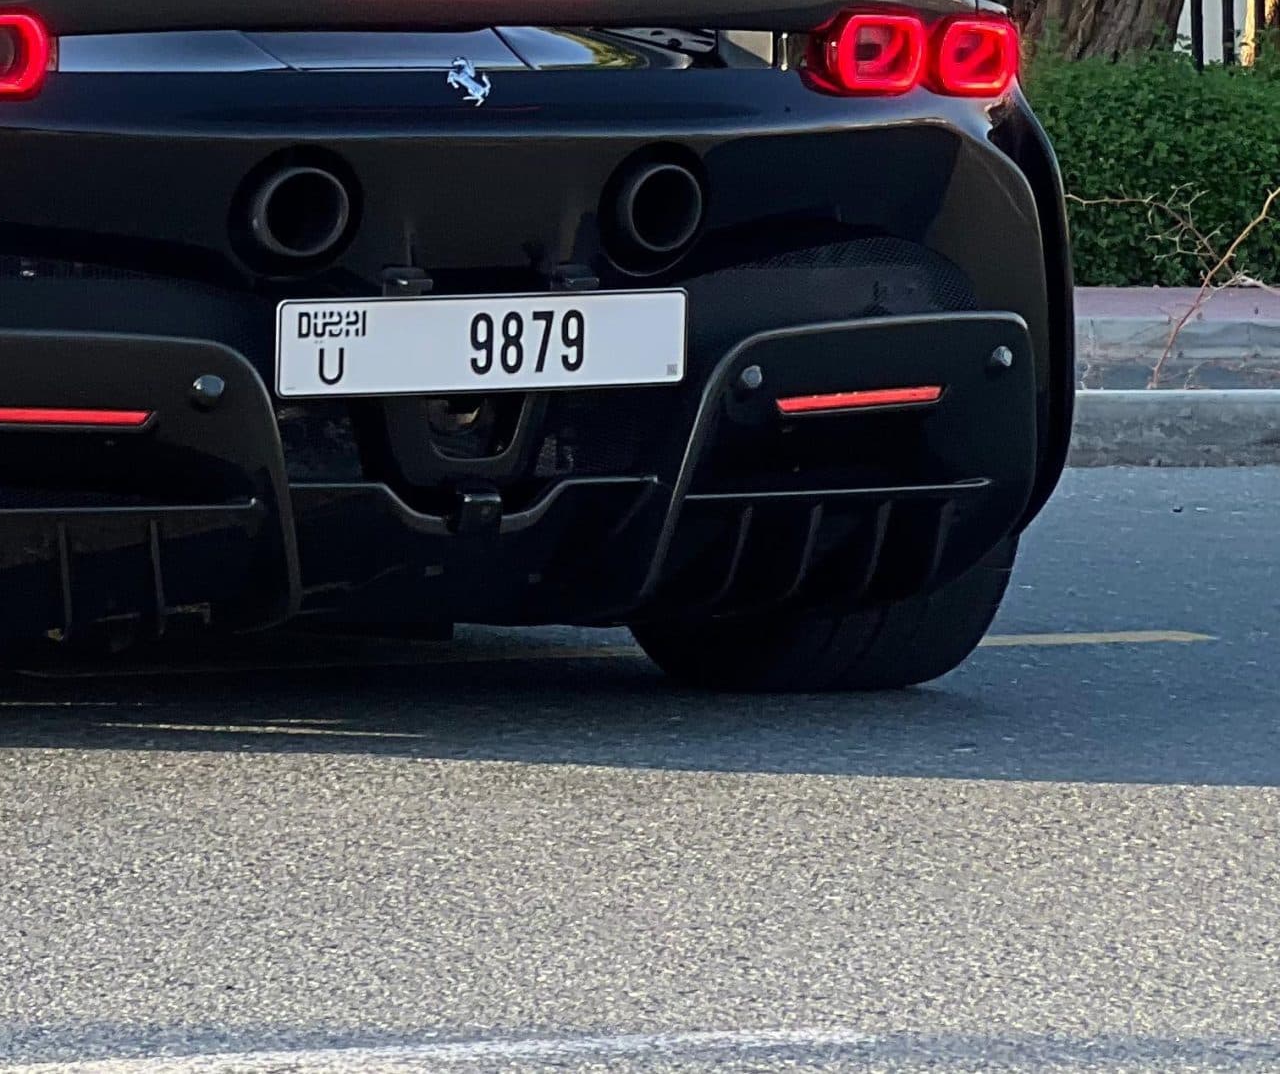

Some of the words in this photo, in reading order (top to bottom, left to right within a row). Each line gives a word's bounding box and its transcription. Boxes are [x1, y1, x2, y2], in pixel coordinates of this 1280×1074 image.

[298, 310, 367, 339] DUBAI
[470, 309, 586, 375] 9879
[318, 347, 345, 385] U
